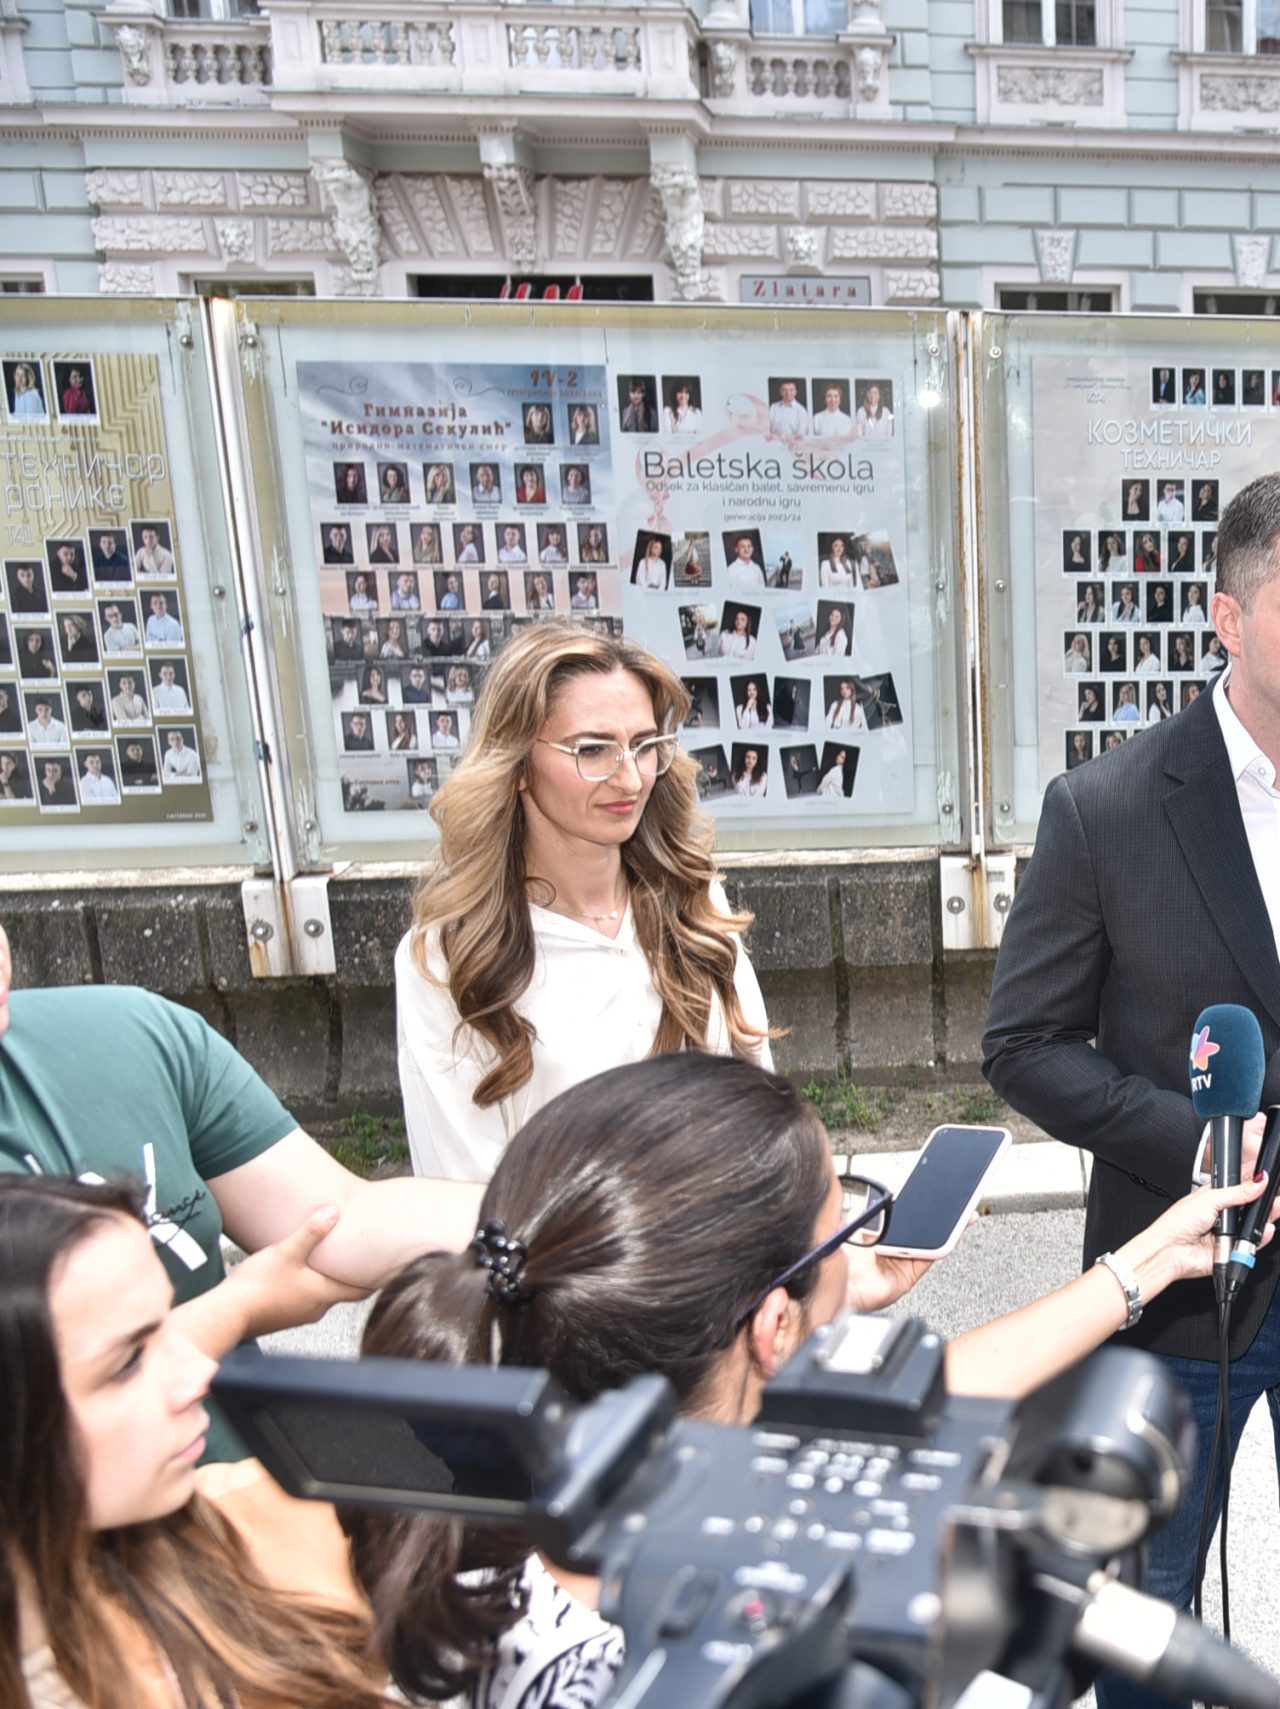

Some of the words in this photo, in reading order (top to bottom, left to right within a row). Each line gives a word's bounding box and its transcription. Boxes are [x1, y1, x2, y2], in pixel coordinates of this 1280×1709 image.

[753, 279, 857, 298] Zlatara
[363, 402, 468, 421] Гимназија
[1087, 418, 1253, 446] КОЗМЕТИЧКИ
[643, 451, 782, 480] Baletska
[792, 452, 874, 481] škola
[1119, 449, 1222, 471] ТЕХНИЧАР
[645, 480, 684, 492] Odsek
[686, 483, 700, 492] za
[702, 480, 750, 492] klasičan
[786, 484, 850, 493] savremenu
[852, 481, 875, 495] igru
[728, 496, 777, 508] narodnu
[779, 497, 801, 510] igru
[1191, 1073, 1212, 1092] RTV
